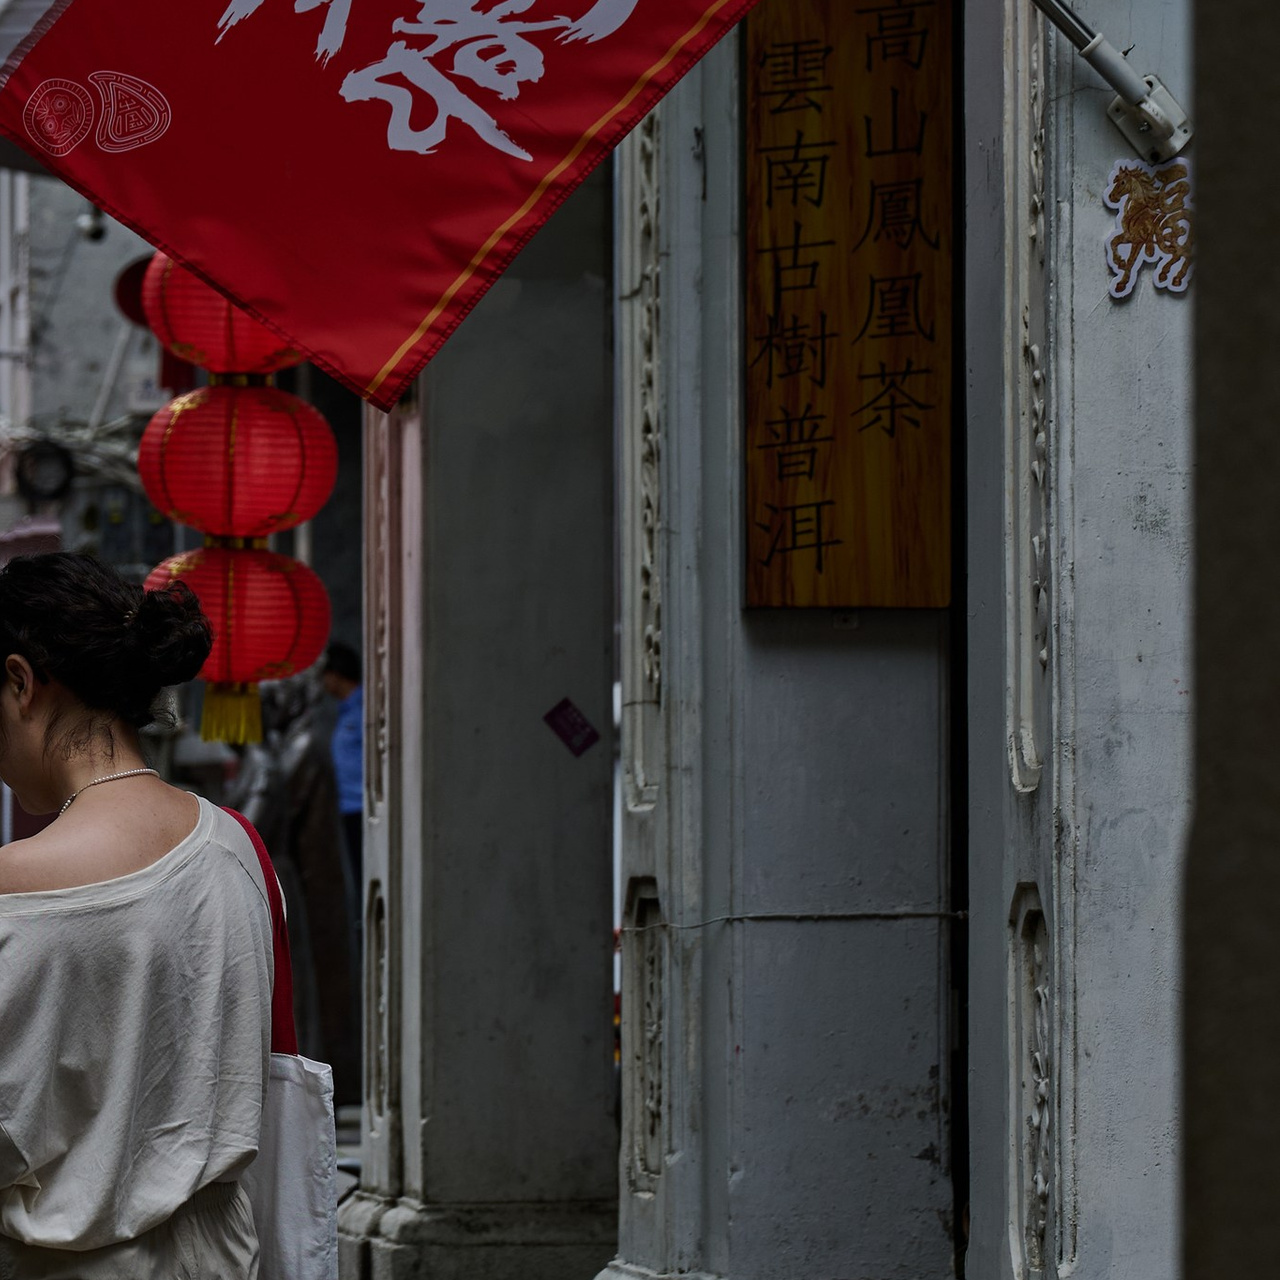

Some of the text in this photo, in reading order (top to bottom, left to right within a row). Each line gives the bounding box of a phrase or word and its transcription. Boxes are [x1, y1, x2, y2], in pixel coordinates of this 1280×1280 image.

[749, 39, 843, 574] 雲南古樹普洱
